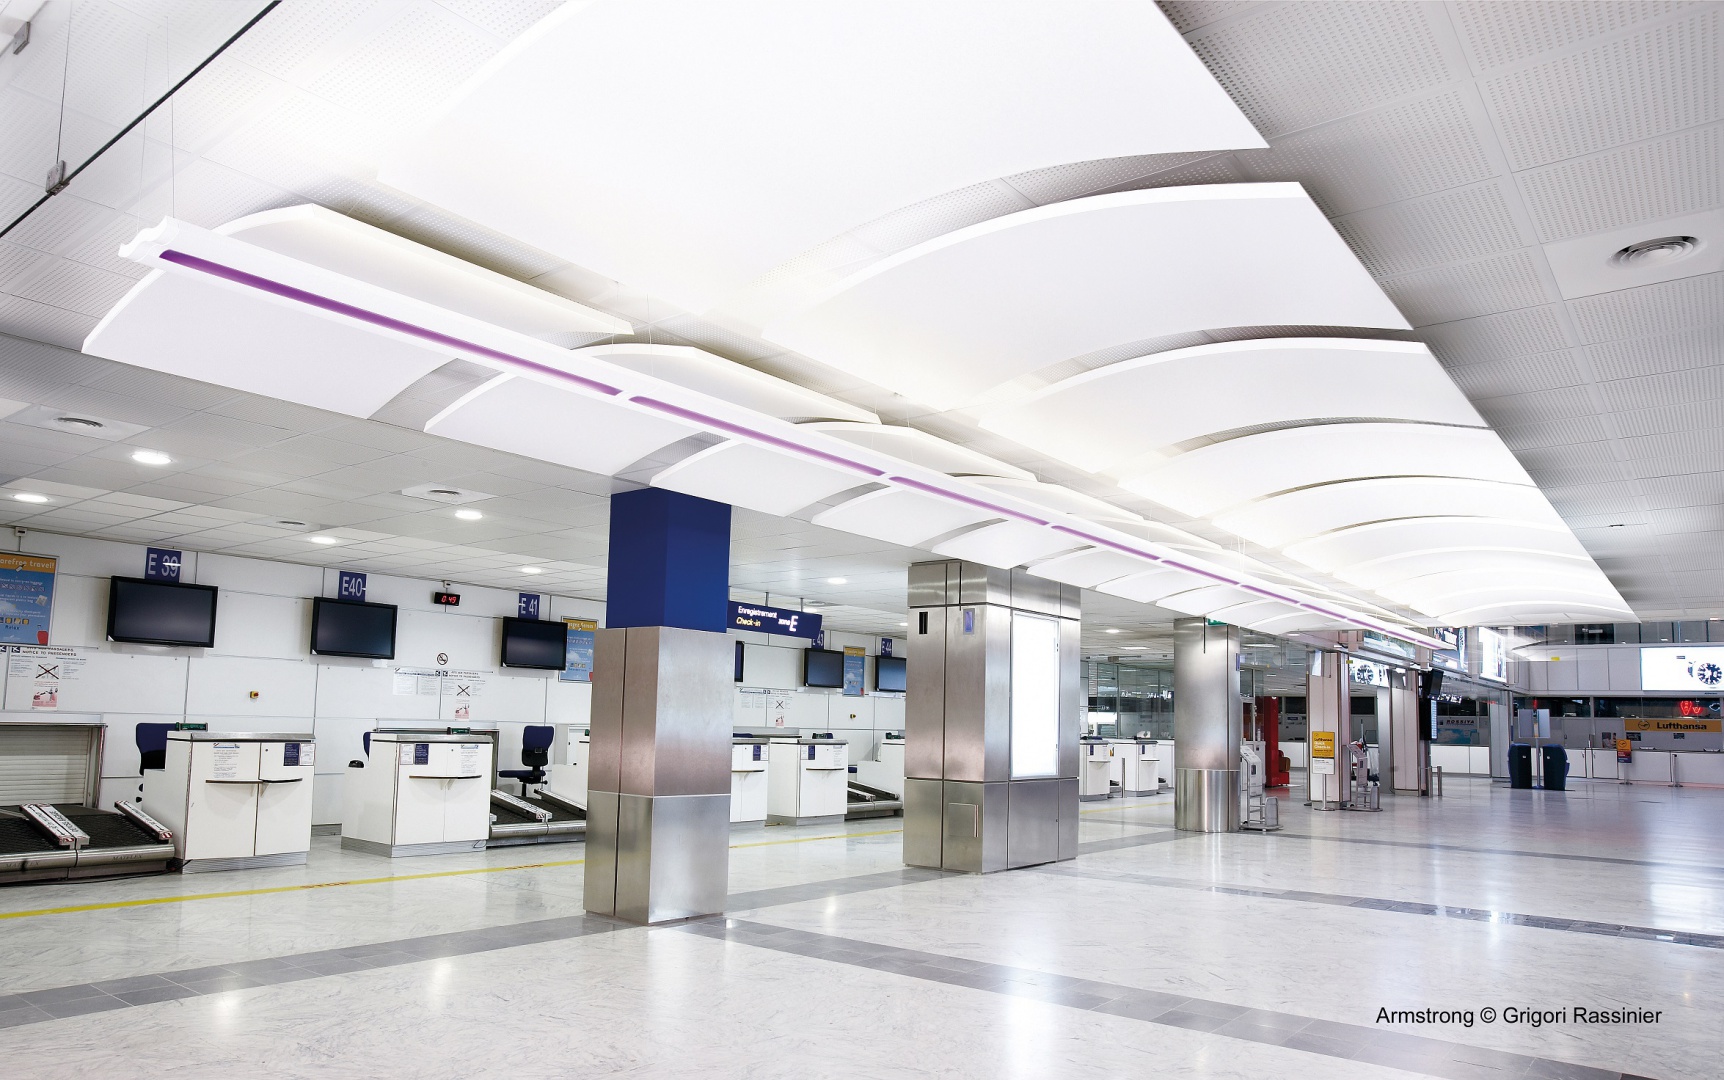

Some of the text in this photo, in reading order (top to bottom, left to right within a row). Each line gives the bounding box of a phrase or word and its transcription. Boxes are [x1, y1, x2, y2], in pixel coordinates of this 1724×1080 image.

[30, 560, 54, 568] travel!
[148, 553, 179, 577] E 39
[342, 576, 363, 597] E40
[520, 598, 538, 616] E 41
[738, 606, 777, 618] Enregistrement
[736, 616, 762, 627] Check-in
[778, 615, 799, 632] zone E
[882, 640, 886, 653] E
[1656, 721, 1707, 730] Lufthansa
